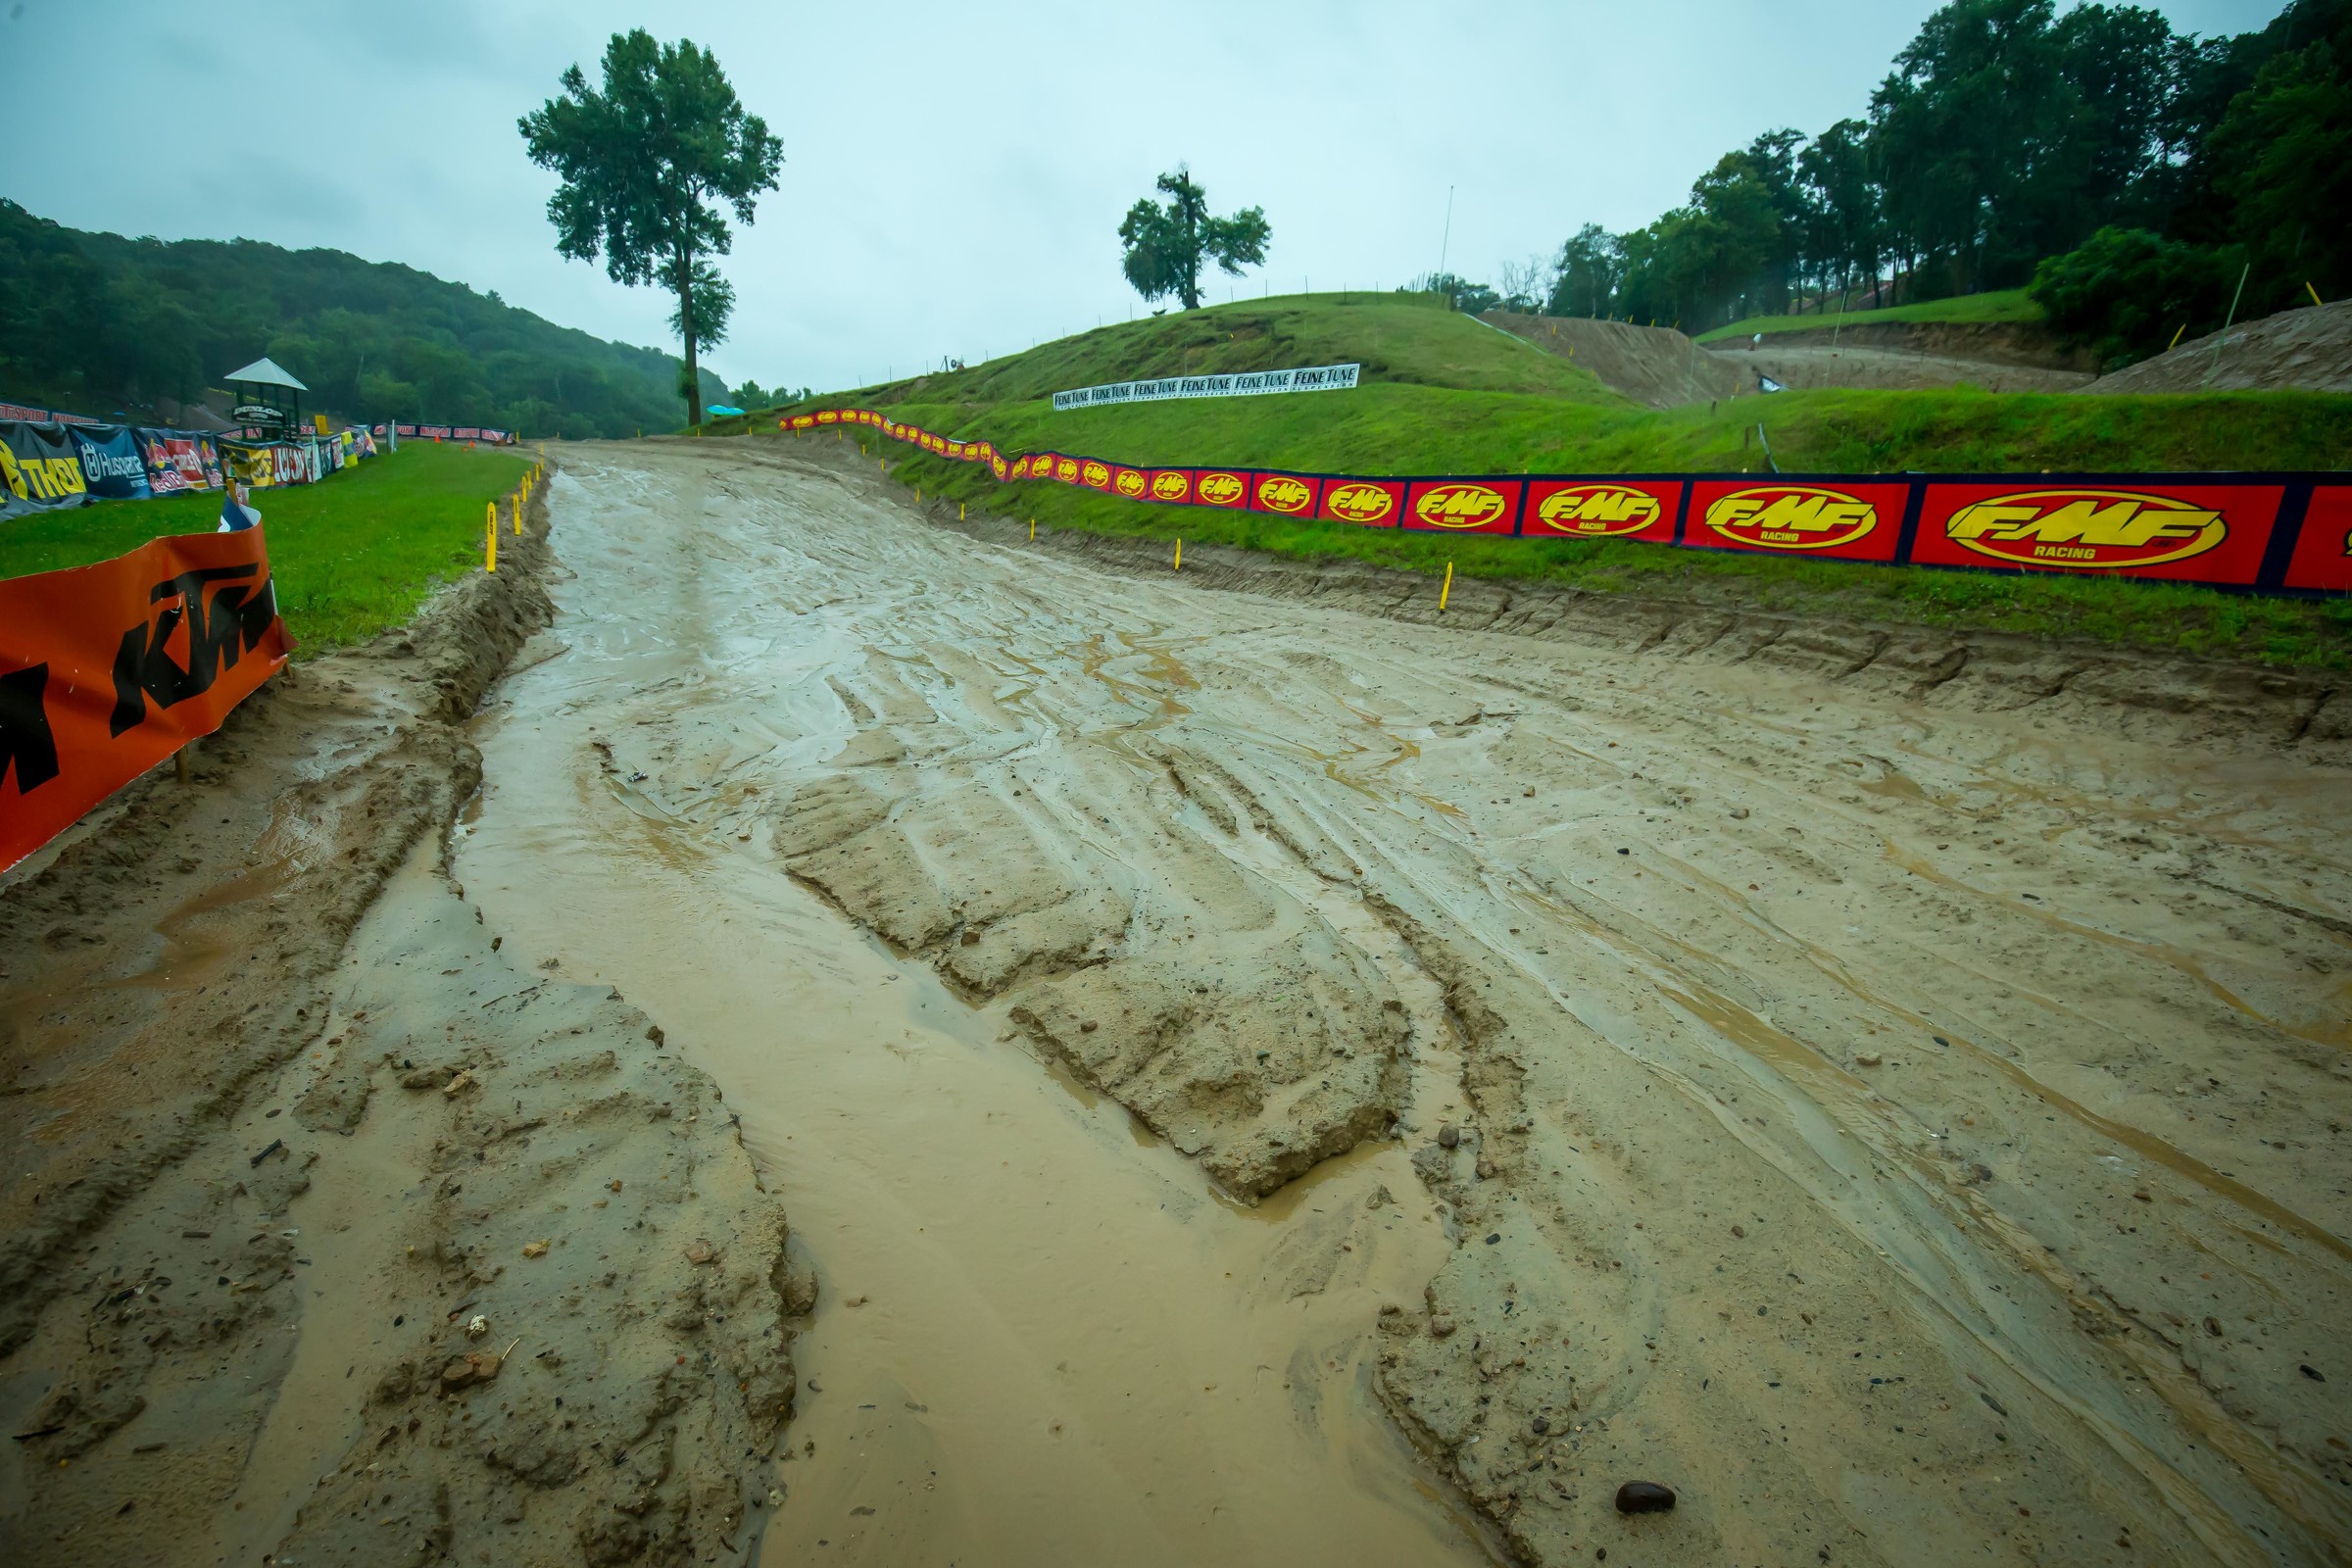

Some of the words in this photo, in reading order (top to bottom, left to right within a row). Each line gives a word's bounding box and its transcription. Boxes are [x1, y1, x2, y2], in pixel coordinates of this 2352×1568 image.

[1181, 379, 1205, 391] FEINE
[1206, 377, 1231, 390] TUNE
[1235, 375, 1263, 389] FEINE
[1263, 373, 1290, 387] TUNE
[1294, 370, 1325, 385] FEINE
[1327, 368, 1355, 382] TUNE
[1116, 473, 1145, 490] FMF
[1152, 475, 1187, 492] FMF
[1199, 477, 1243, 496] FMF
[1258, 482, 1311, 504] FMF
[1328, 488, 1392, 512] FMF
[1416, 490, 1504, 515] FMF
[1539, 490, 1659, 522] FMF
[1705, 494, 1874, 532] FMF
[1945, 499, 2227, 547] FMF
[1760, 530, 1800, 542] RACING
[2034, 545, 2096, 560] RACING
[110, 562, 275, 739] KTM
